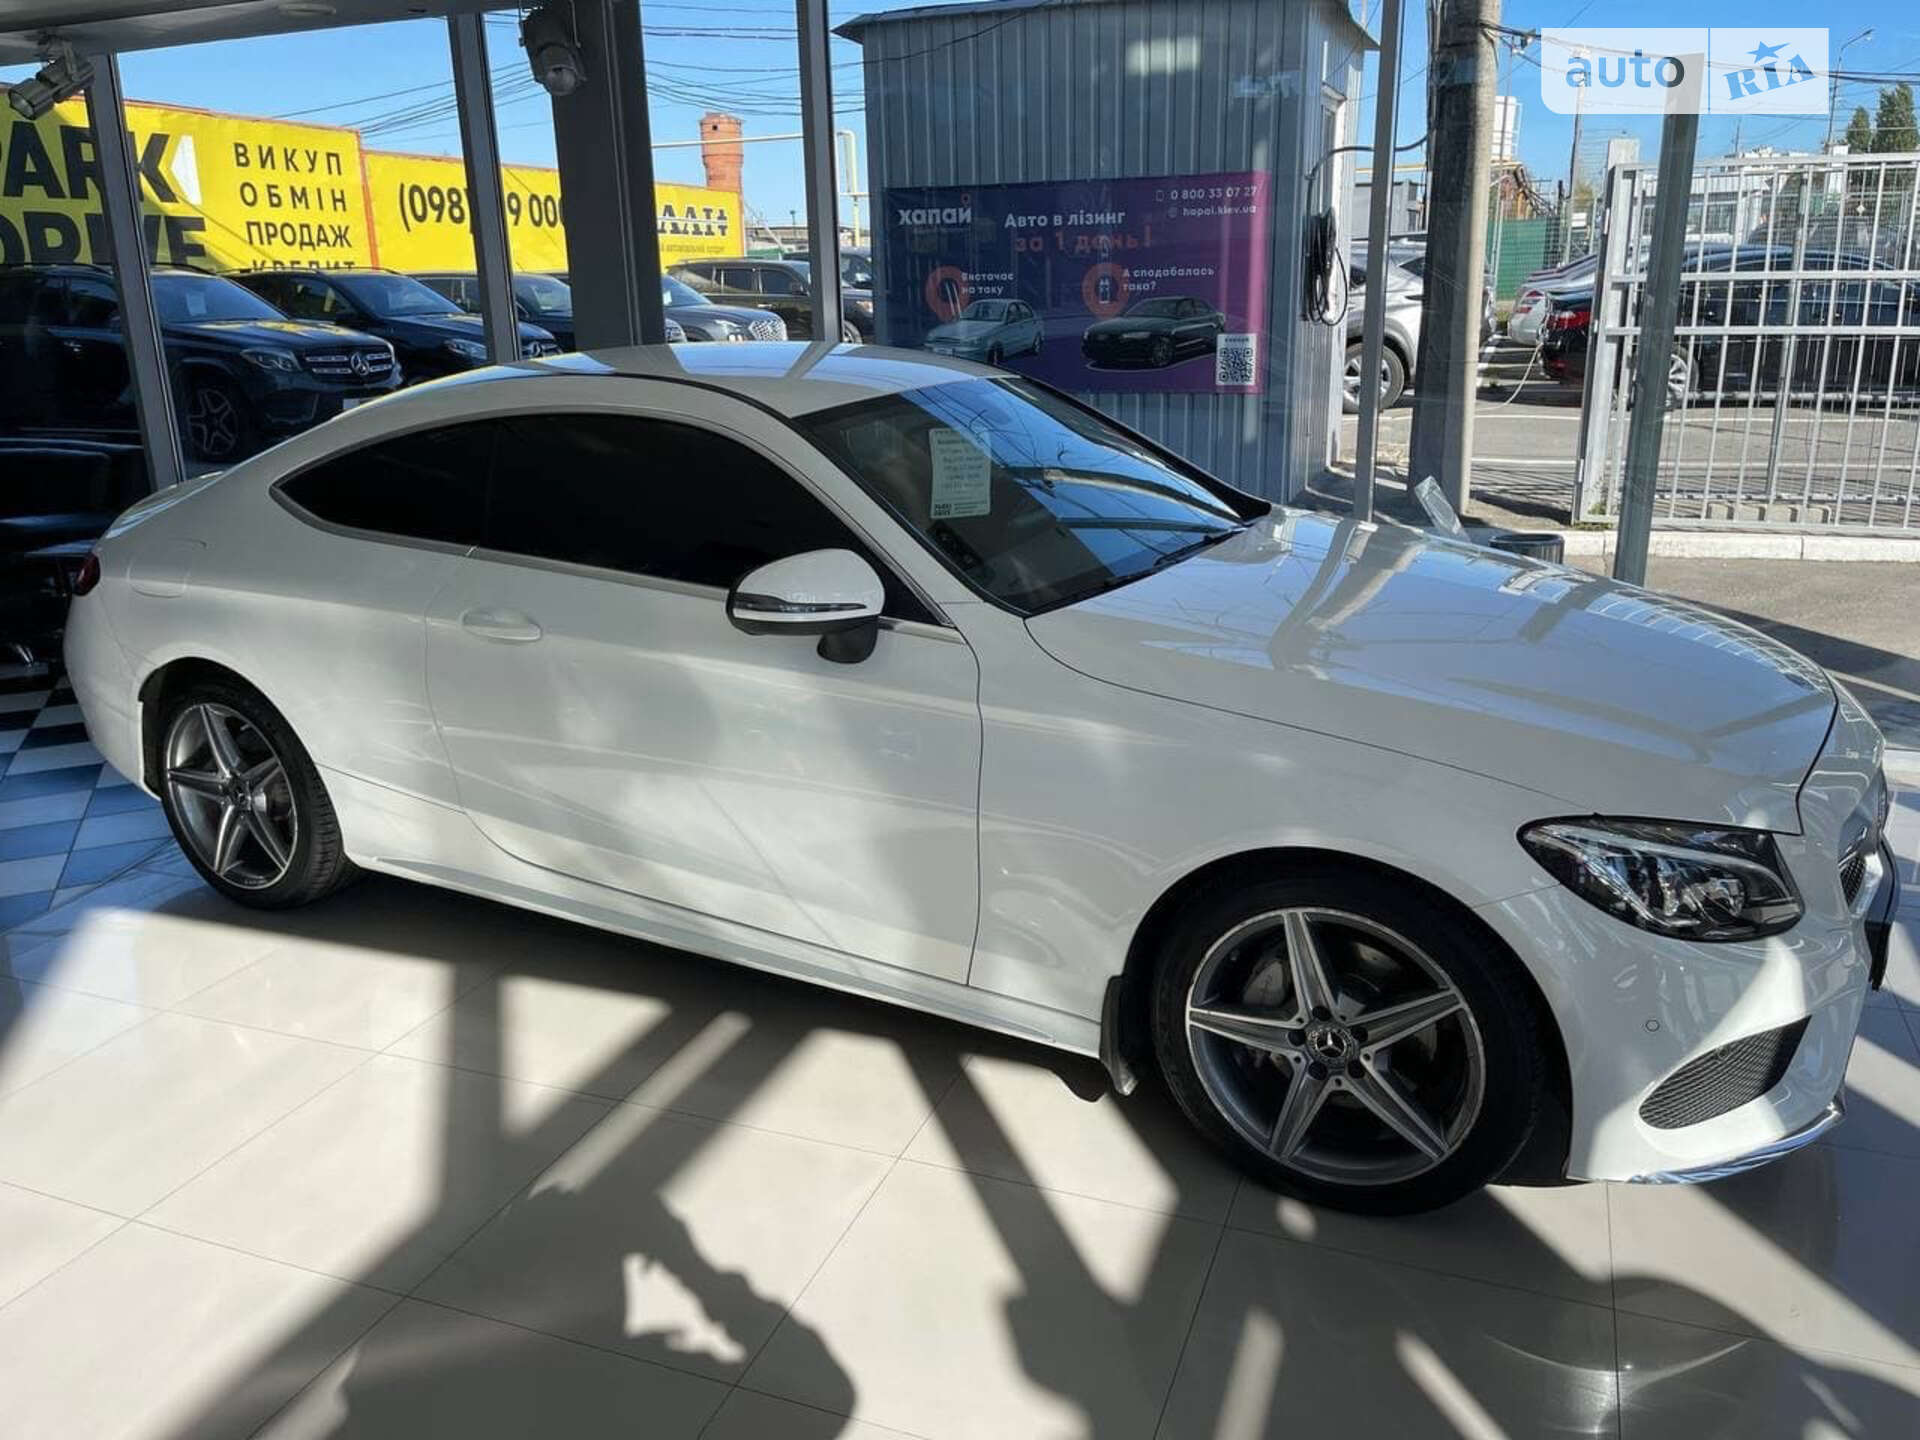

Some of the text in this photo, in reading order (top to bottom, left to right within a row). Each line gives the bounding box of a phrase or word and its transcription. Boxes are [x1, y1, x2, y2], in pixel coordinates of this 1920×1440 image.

[0, 121, 180, 203] ARK
[234, 142, 342, 175] ВИКУП
[240, 182, 346, 212] ОБМІН
[1171, 186, 1258, 200] 0 800 33 07 27
[528, 194, 564, 228] 00
[898, 202, 972, 225] хапай
[1004, 210, 1126, 228] Авто в лізинг
[246, 221, 352, 251] ПРОДАЖ
[1015, 237, 1042, 252] за
